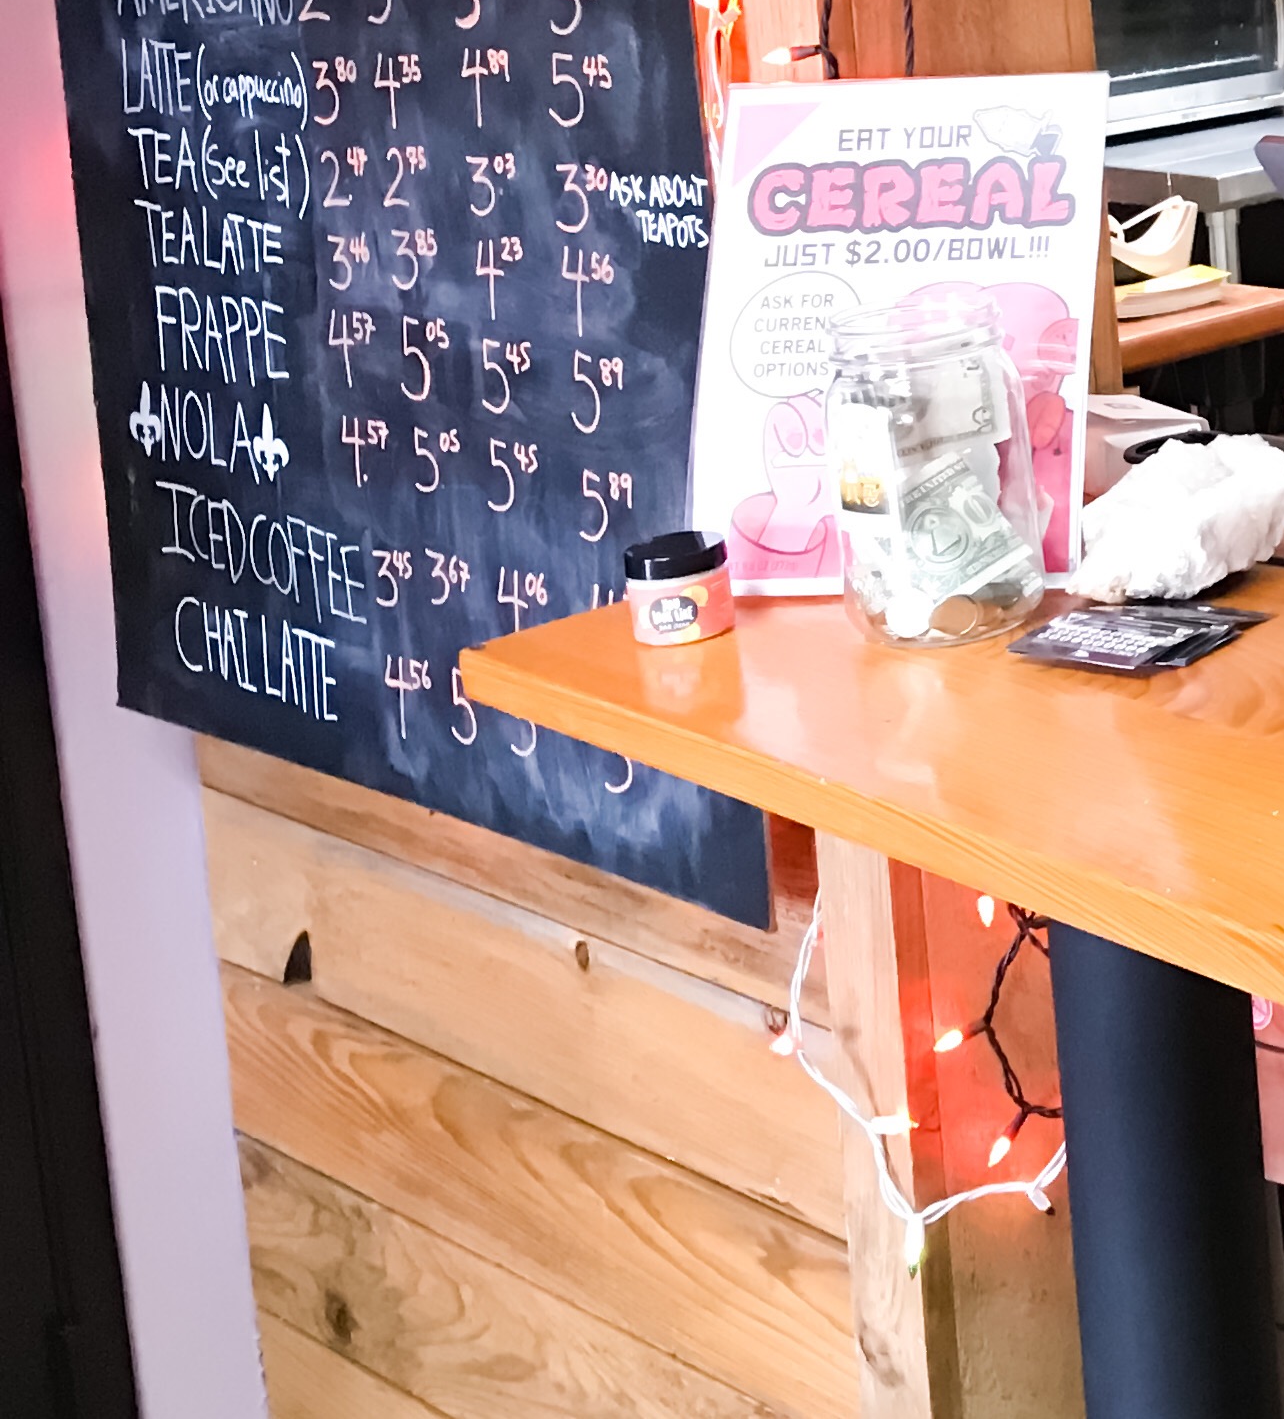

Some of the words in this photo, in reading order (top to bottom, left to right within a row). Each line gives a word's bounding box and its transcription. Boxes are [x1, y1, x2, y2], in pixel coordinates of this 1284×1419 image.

[121, 38, 192, 116] LATTE
[127, 126, 198, 193] TEA
[838, 128, 891, 152] EAT
[903, 124, 972, 150] YOUR
[609, 171, 646, 208] ASK
[649, 174, 708, 209] ABOUT
[749, 157, 1074, 235] CEREAL
[133, 199, 199, 267] TEA
[202, 205, 284, 275] LATTE
[636, 209, 709, 248] TEAPOTS
[764, 242, 835, 268] JUST
[845, 235, 1050, 268] $2.00/BOWL!!!
[753, 317, 832, 333] CURREN
[760, 294, 794, 310] ASK
[800, 294, 834, 309] FOR
[155, 285, 290, 387] FRAPPE
[760, 340, 826, 355] CEREAL
[753, 362, 829, 378] OPTIONS
[160, 384, 260, 485] NOLA
[155, 480, 246, 584] ICED
[250, 514, 367, 624] COFFEE
[175, 596, 258, 692] CHAI
[261, 614, 338, 722] LATTE
